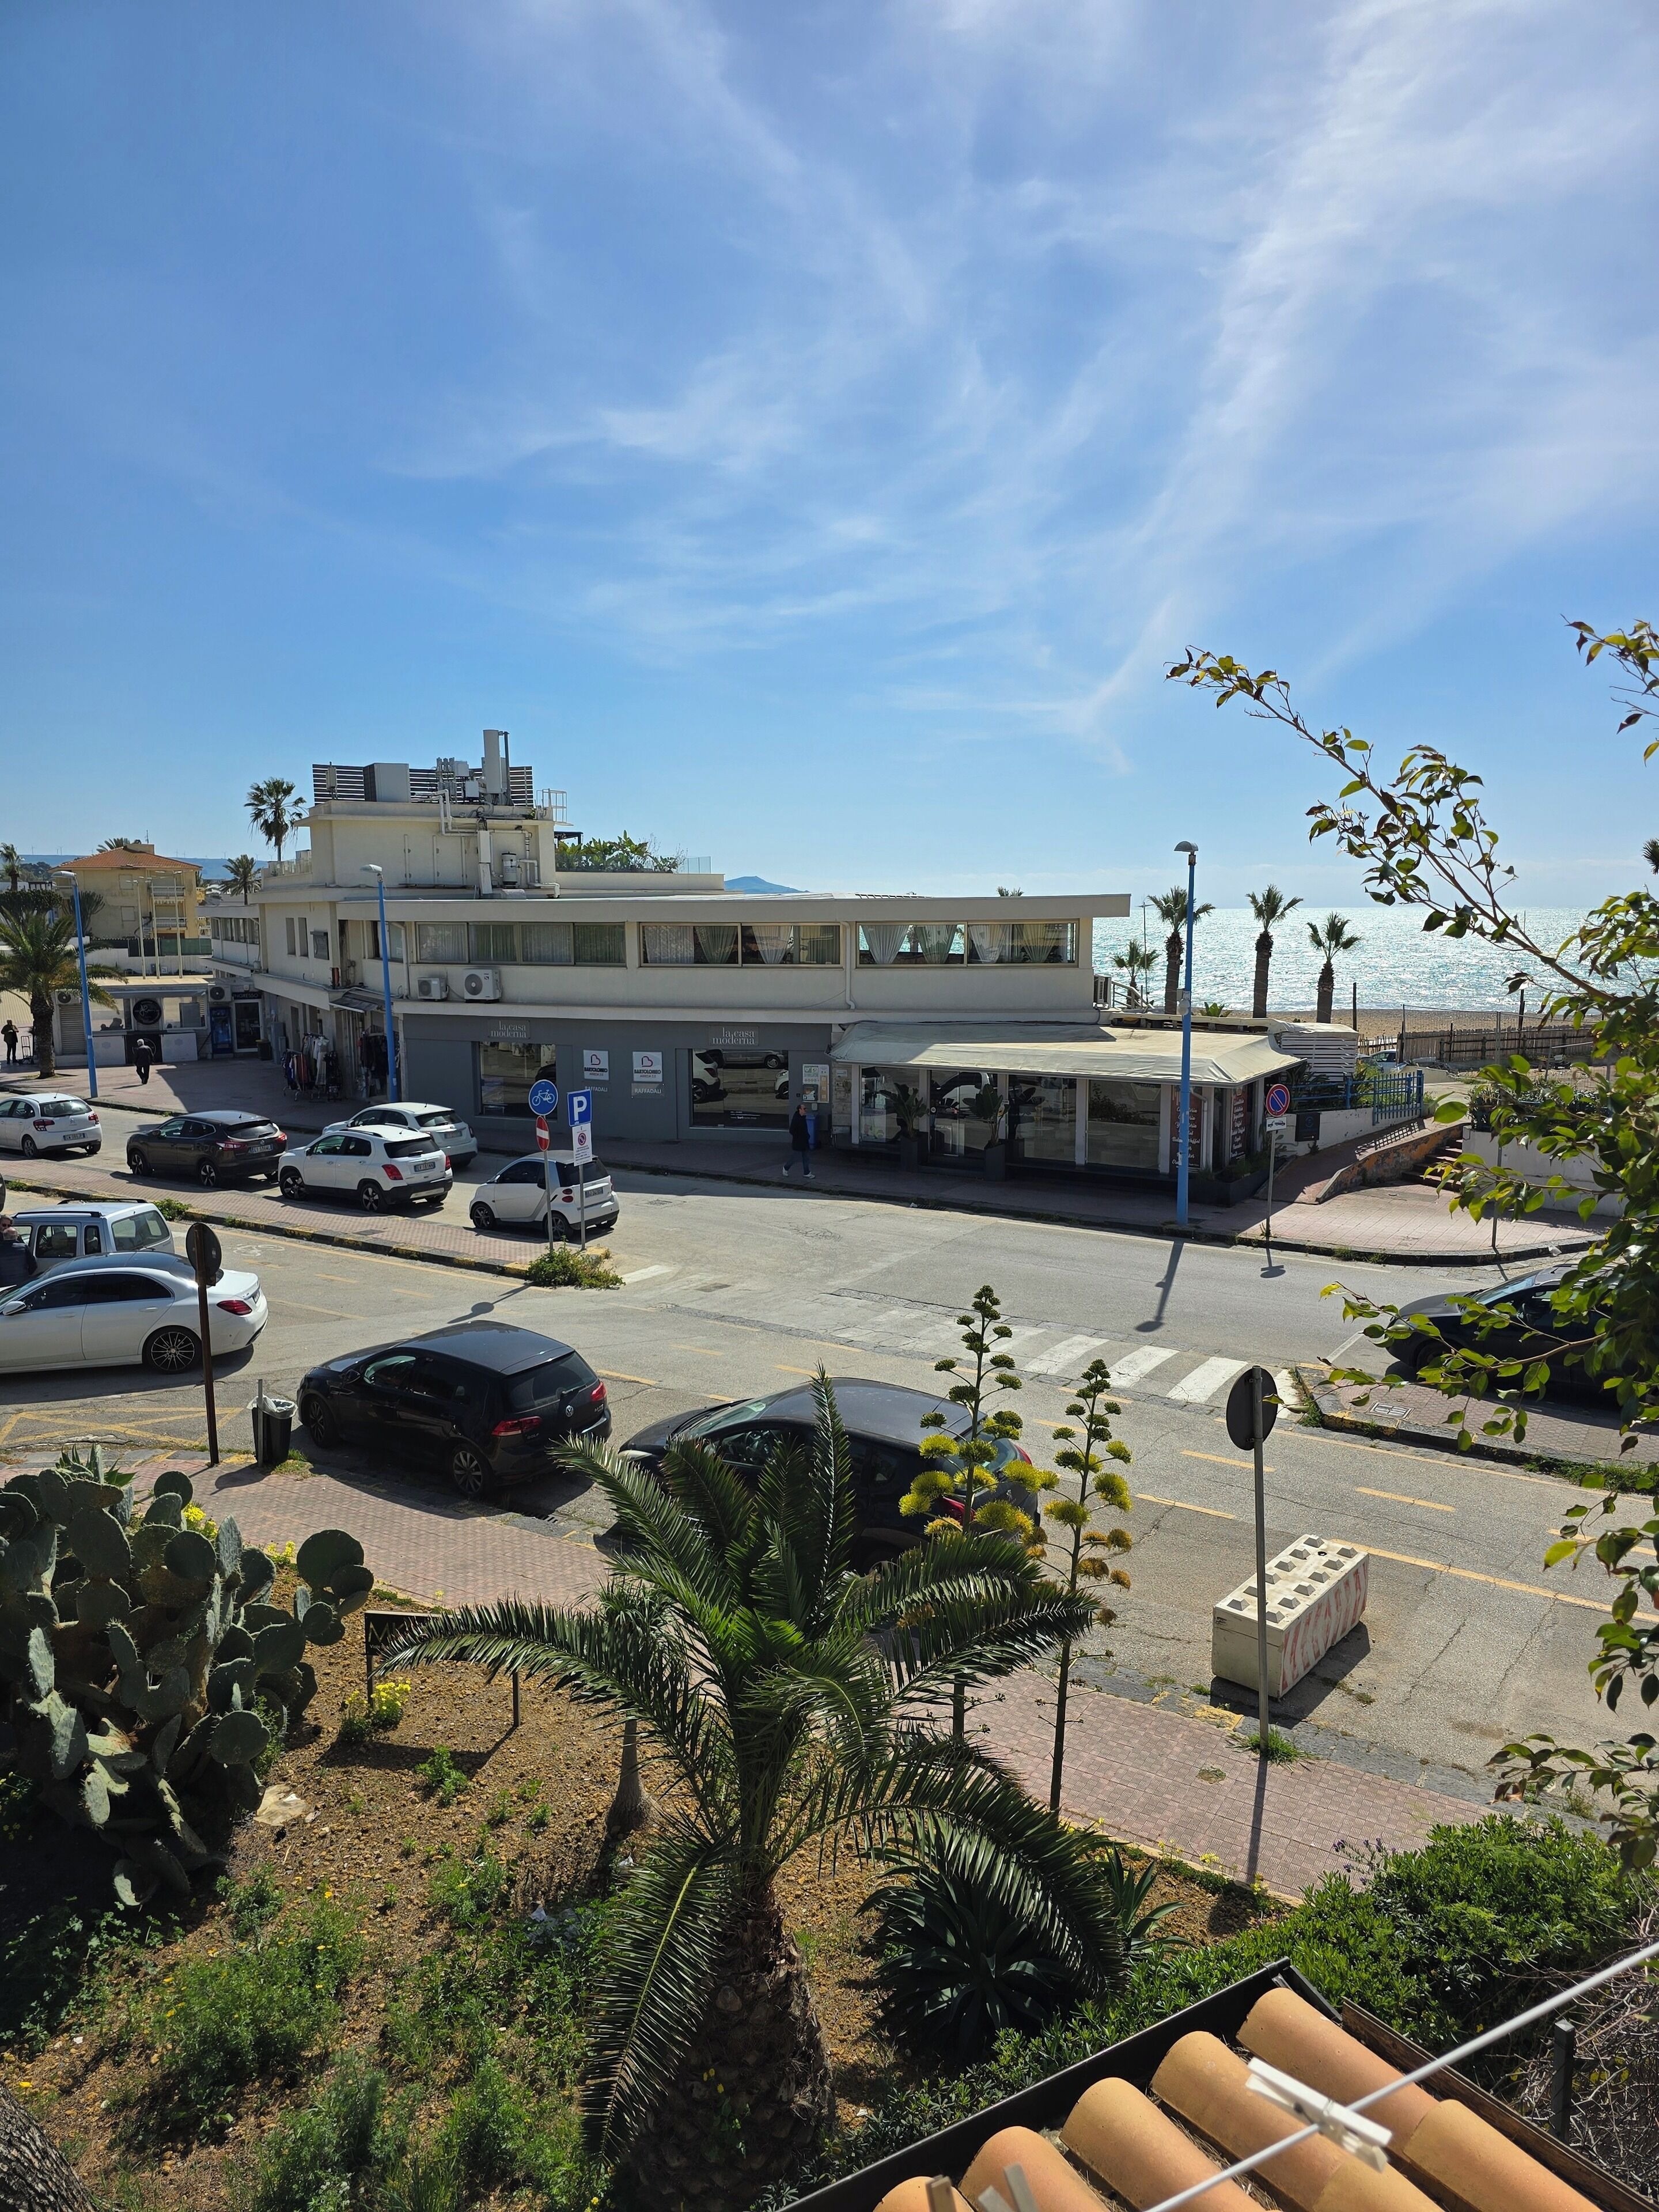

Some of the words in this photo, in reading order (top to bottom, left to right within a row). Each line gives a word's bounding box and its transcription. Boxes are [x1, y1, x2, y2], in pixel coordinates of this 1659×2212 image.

[499, 1020, 506, 1031] la
[491, 1028, 527, 1038] moderna
[722, 1027, 731, 1037] la
[713, 1034, 755, 1044] moderna
[573, 1096, 587, 1121] P
